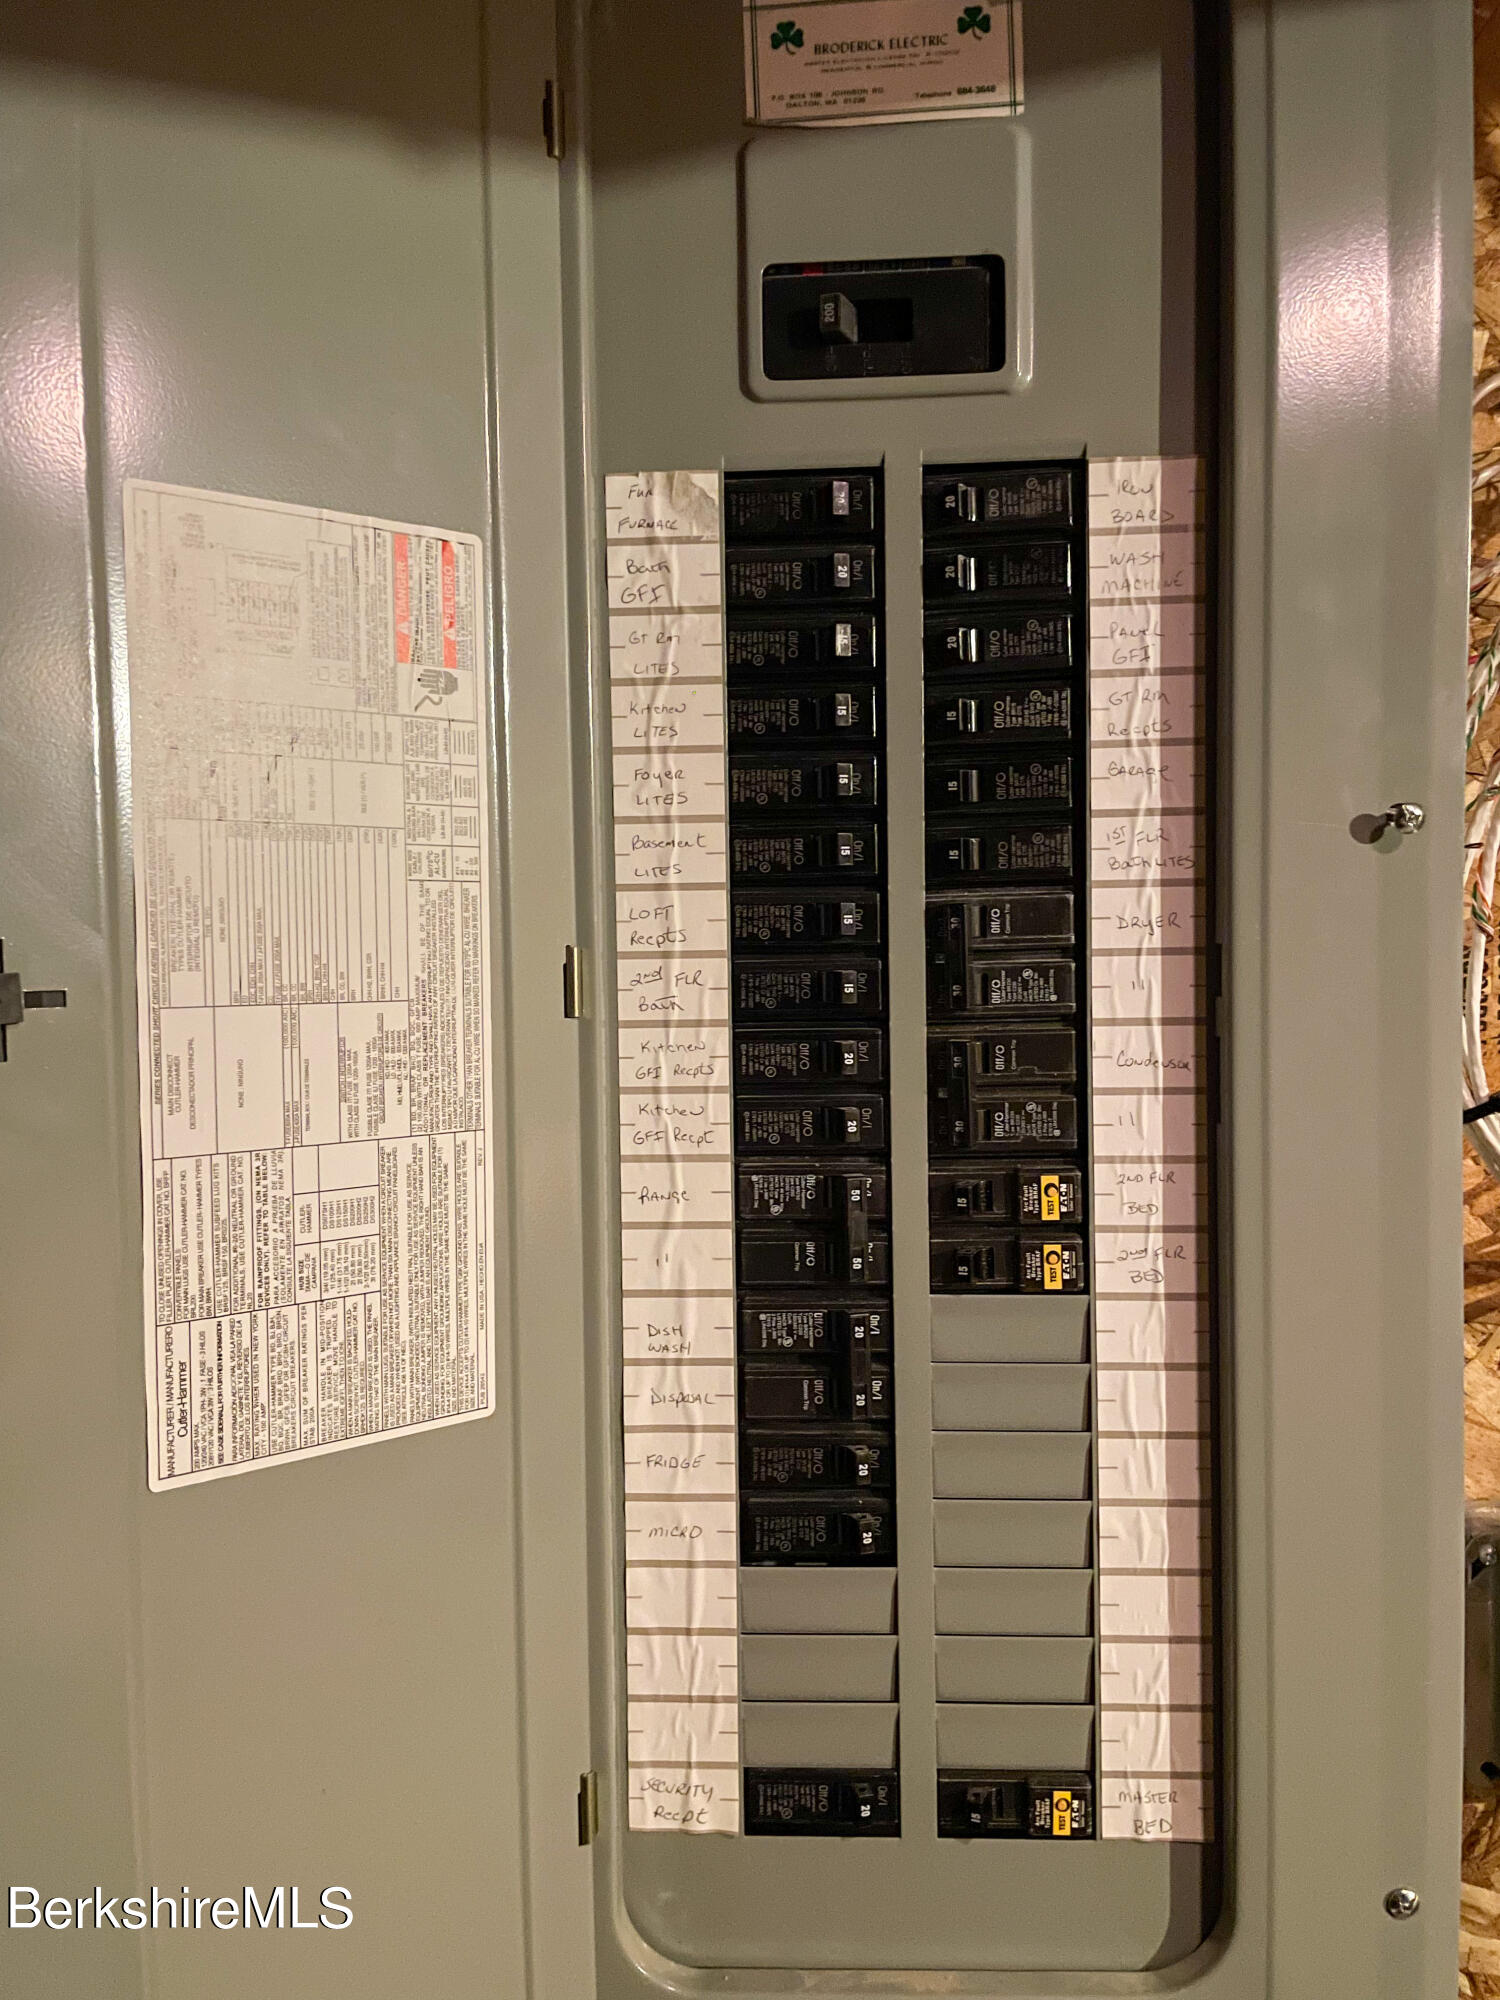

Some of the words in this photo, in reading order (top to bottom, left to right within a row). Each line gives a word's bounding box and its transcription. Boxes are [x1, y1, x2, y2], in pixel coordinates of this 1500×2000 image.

[814, 39, 884, 55] BRODERICK
[890, 34, 948, 49] ELECTRIC
[825, 303, 835, 322] 200
[945, 495, 956, 508] 20
[1111, 508, 1175, 524] BOARD
[617, 517, 679, 534] FURNACE
[1110, 551, 1165, 566] WASH
[837, 565, 848, 578] 20
[945, 565, 955, 578] 20
[396, 561, 407, 616] DANGER
[444, 565, 454, 623] PELIGRO
[620, 583, 665, 604] GFI
[947, 636, 958, 649] 20
[1112, 644, 1155, 665] GFI
[633, 663, 680, 676] LITES
[629, 702, 687, 714] Kitchen
[837, 705, 847, 716] 15
[946, 711, 956, 721] 15
[633, 726, 680, 738] LITES
[838, 774, 849, 784] 15
[948, 781, 958, 791] 15
[636, 792, 688, 806] LITES
[631, 834, 706, 850] Basement
[1136, 827, 1169, 845] FLR
[840, 846, 850, 856] 15
[949, 850, 959, 860] 15
[634, 864, 682, 878] LITES
[628, 904, 674, 921] LOFT
[843, 914, 853, 925] 15
[674, 969, 704, 987] FLR
[844, 983, 854, 993] 15
[640, 1040, 705, 1054] Kitchen
[844, 1052, 854, 1065] 20
[953, 1056, 963, 1069] 30
[166, 1054, 174, 1096] DISCONNECT
[635, 1066, 662, 1080] GFI
[638, 1103, 705, 1117] Kitchen
[847, 1120, 857, 1133] 20
[955, 1120, 965, 1133] 30
[632, 1130, 664, 1145] GFI
[1150, 1171, 1176, 1184] FLR
[850, 1189, 861, 1201] 50
[957, 1197, 967, 1207] 15
[1125, 1201, 1159, 1216] BED
[1154, 1245, 1187, 1259] FLR
[852, 1257, 862, 1270] 50
[959, 1266, 969, 1276] 15
[1129, 1267, 1165, 1284] BED
[854, 1326, 864, 1339] 20
[647, 1341, 691, 1355] WASH
[165, 1326, 174, 1401] MANUFACTURERO
[177, 1360, 188, 1437] Cutler-Hammer
[856, 1394, 865, 1407] 20
[166, 1407, 175, 1475] MANUFACTURER
[645, 1454, 706, 1469] FRIDGE
[858, 1464, 868, 1476] 20
[648, 1526, 703, 1539] MICRO
[862, 1531, 872, 1545] 20
[640, 1776, 714, 1802] SECURITY
[1118, 1792, 1177, 1805] MASTER
[860, 1804, 871, 1817] 20
[971, 1813, 981, 1823] 15
[1058, 1815, 1066, 1831] TEST
[1133, 1819, 1173, 1835] BED
